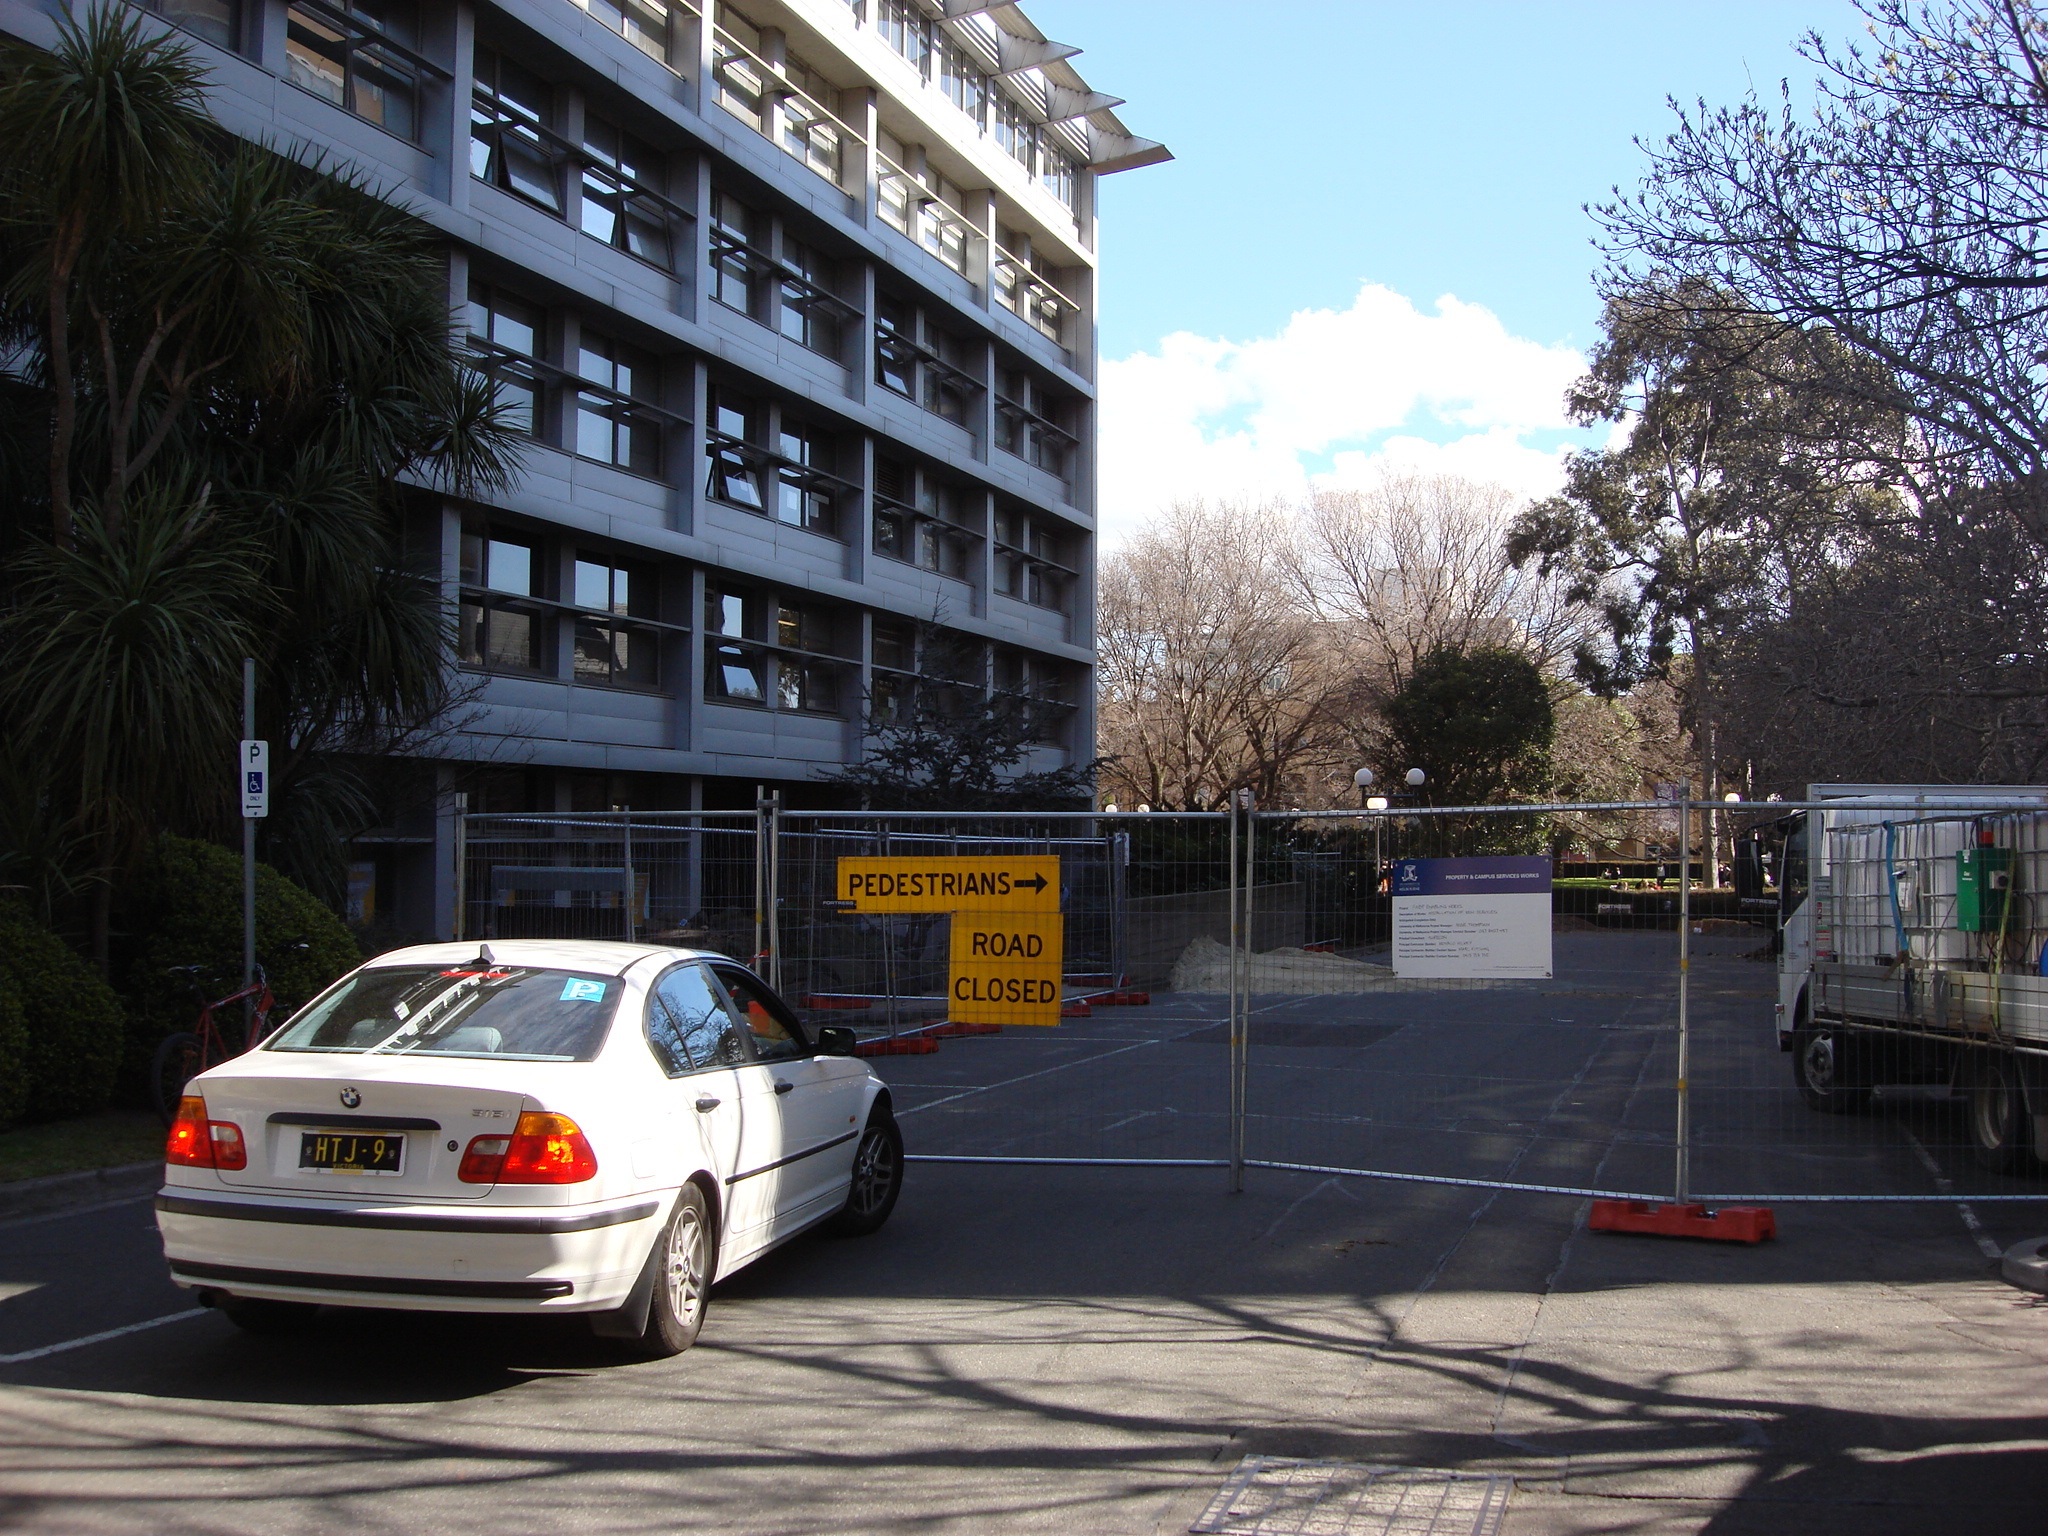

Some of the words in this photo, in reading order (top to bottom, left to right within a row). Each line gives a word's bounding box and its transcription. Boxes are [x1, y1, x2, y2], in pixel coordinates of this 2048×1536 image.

[250, 745, 260, 763] P
[849, 872, 1011, 897] PEDESTRIANS
[972, 932, 1043, 957] ROAD
[954, 976, 1056, 1003] CLOSED
